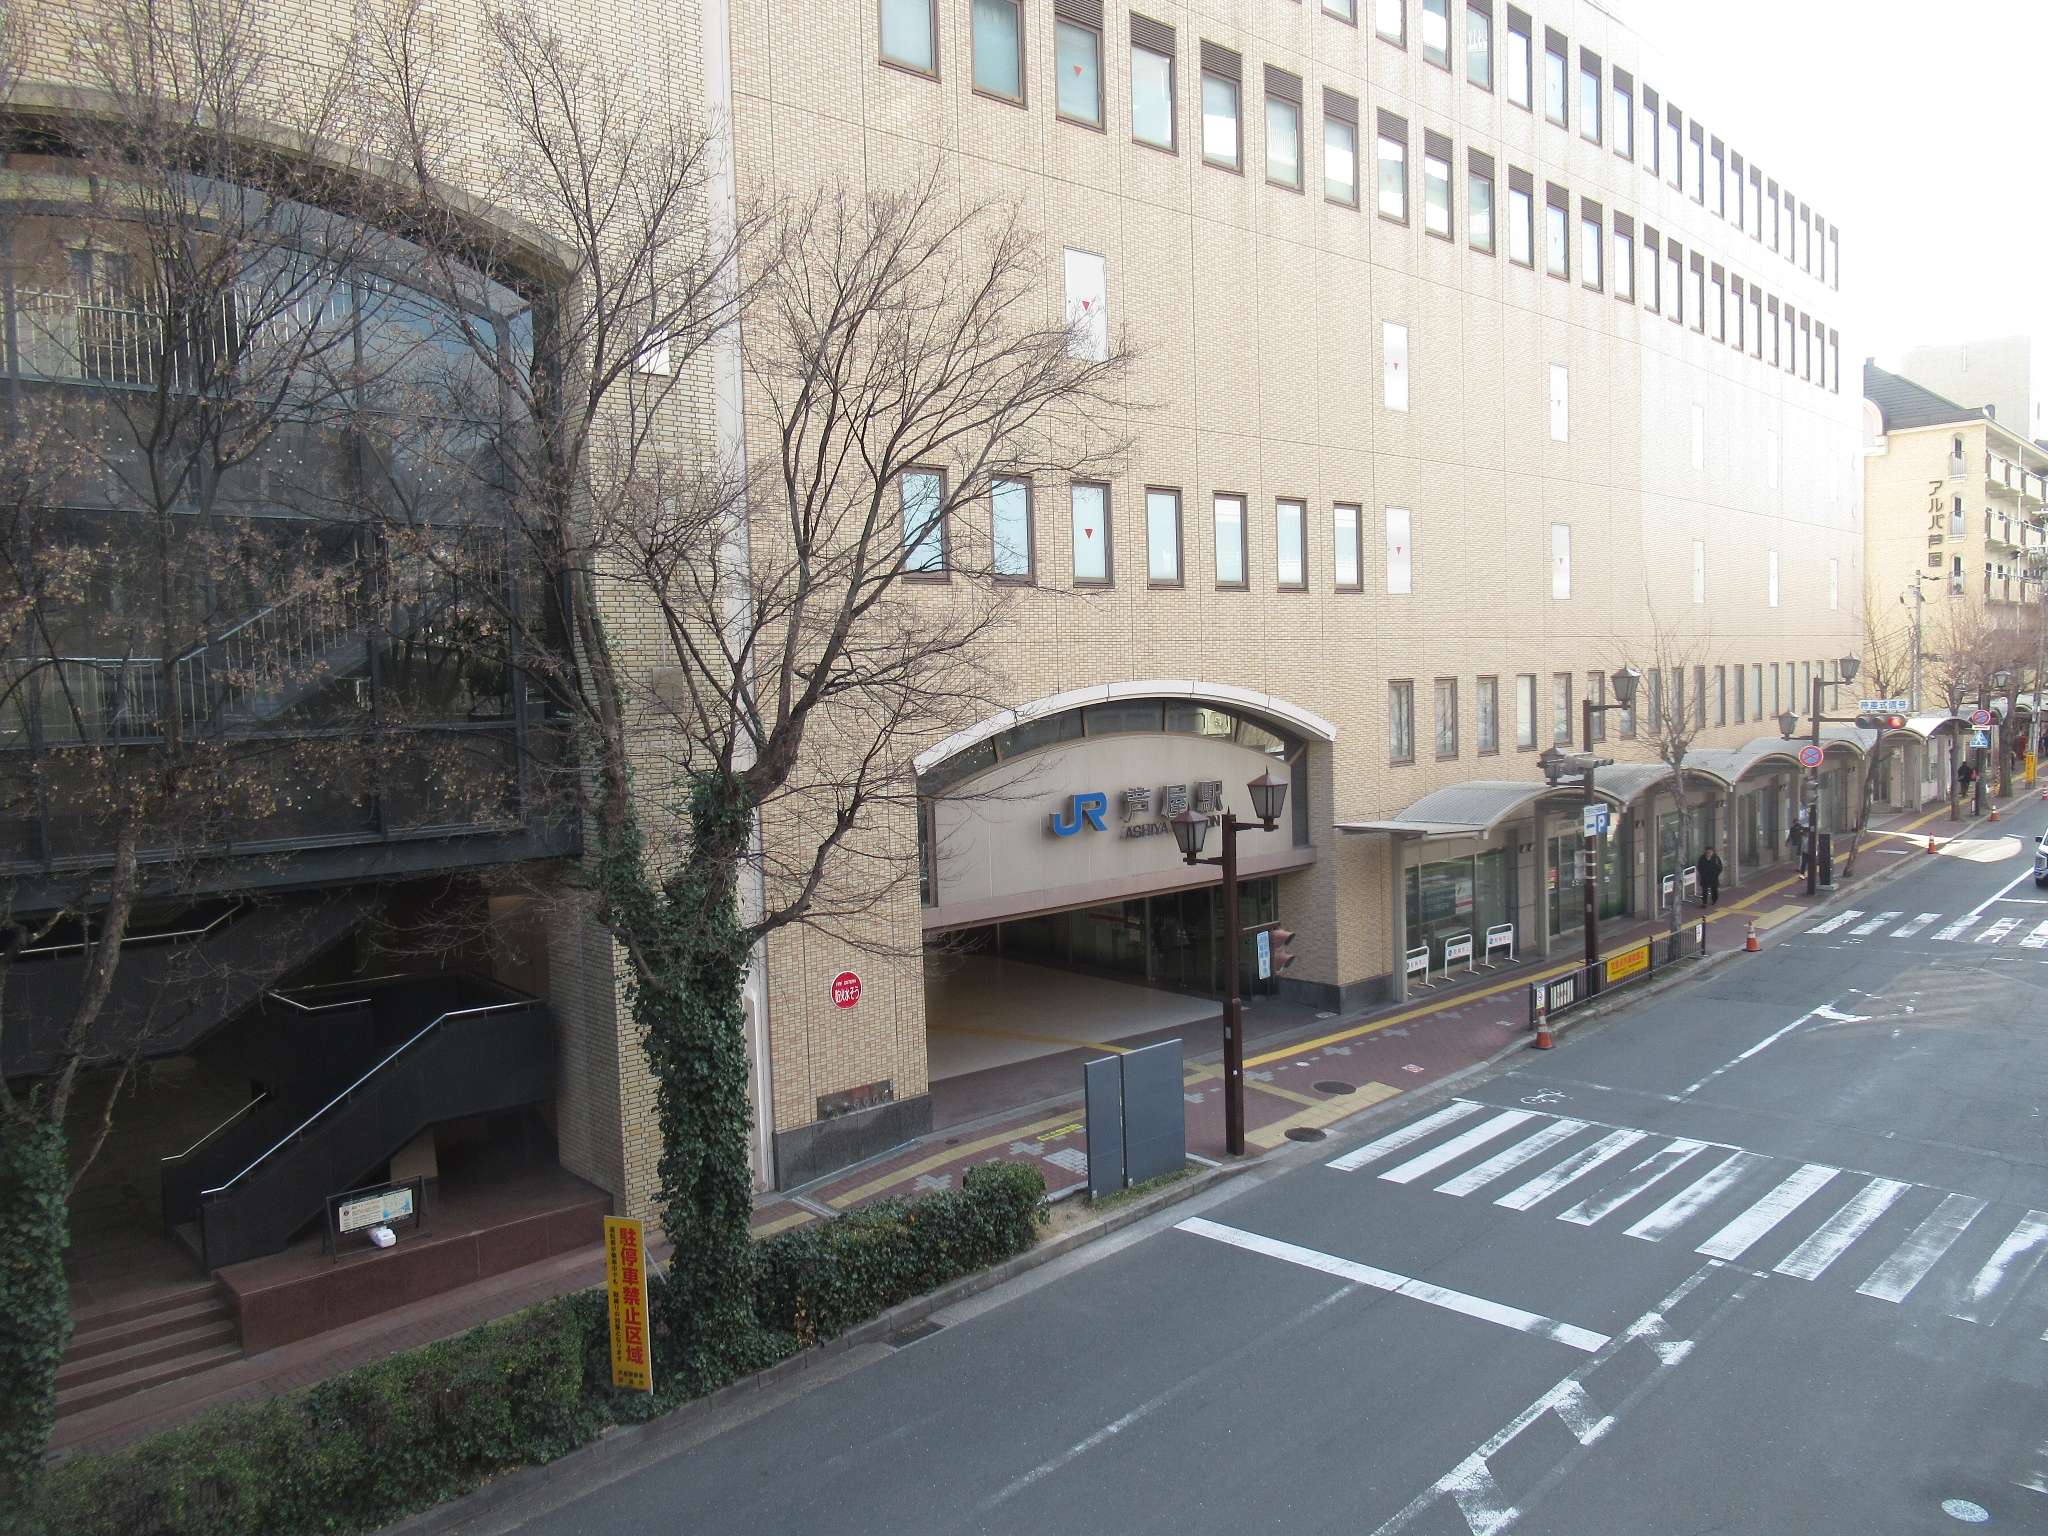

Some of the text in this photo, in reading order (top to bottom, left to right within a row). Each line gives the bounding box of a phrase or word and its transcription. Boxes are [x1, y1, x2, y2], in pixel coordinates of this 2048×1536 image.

[1053, 780, 1223, 837] JR 芦屋駅
[1598, 814, 1605, 832] P
[1126, 821, 1168, 838] ASHIYA
[619, 1227, 644, 1365] 駐停車禁止区域
